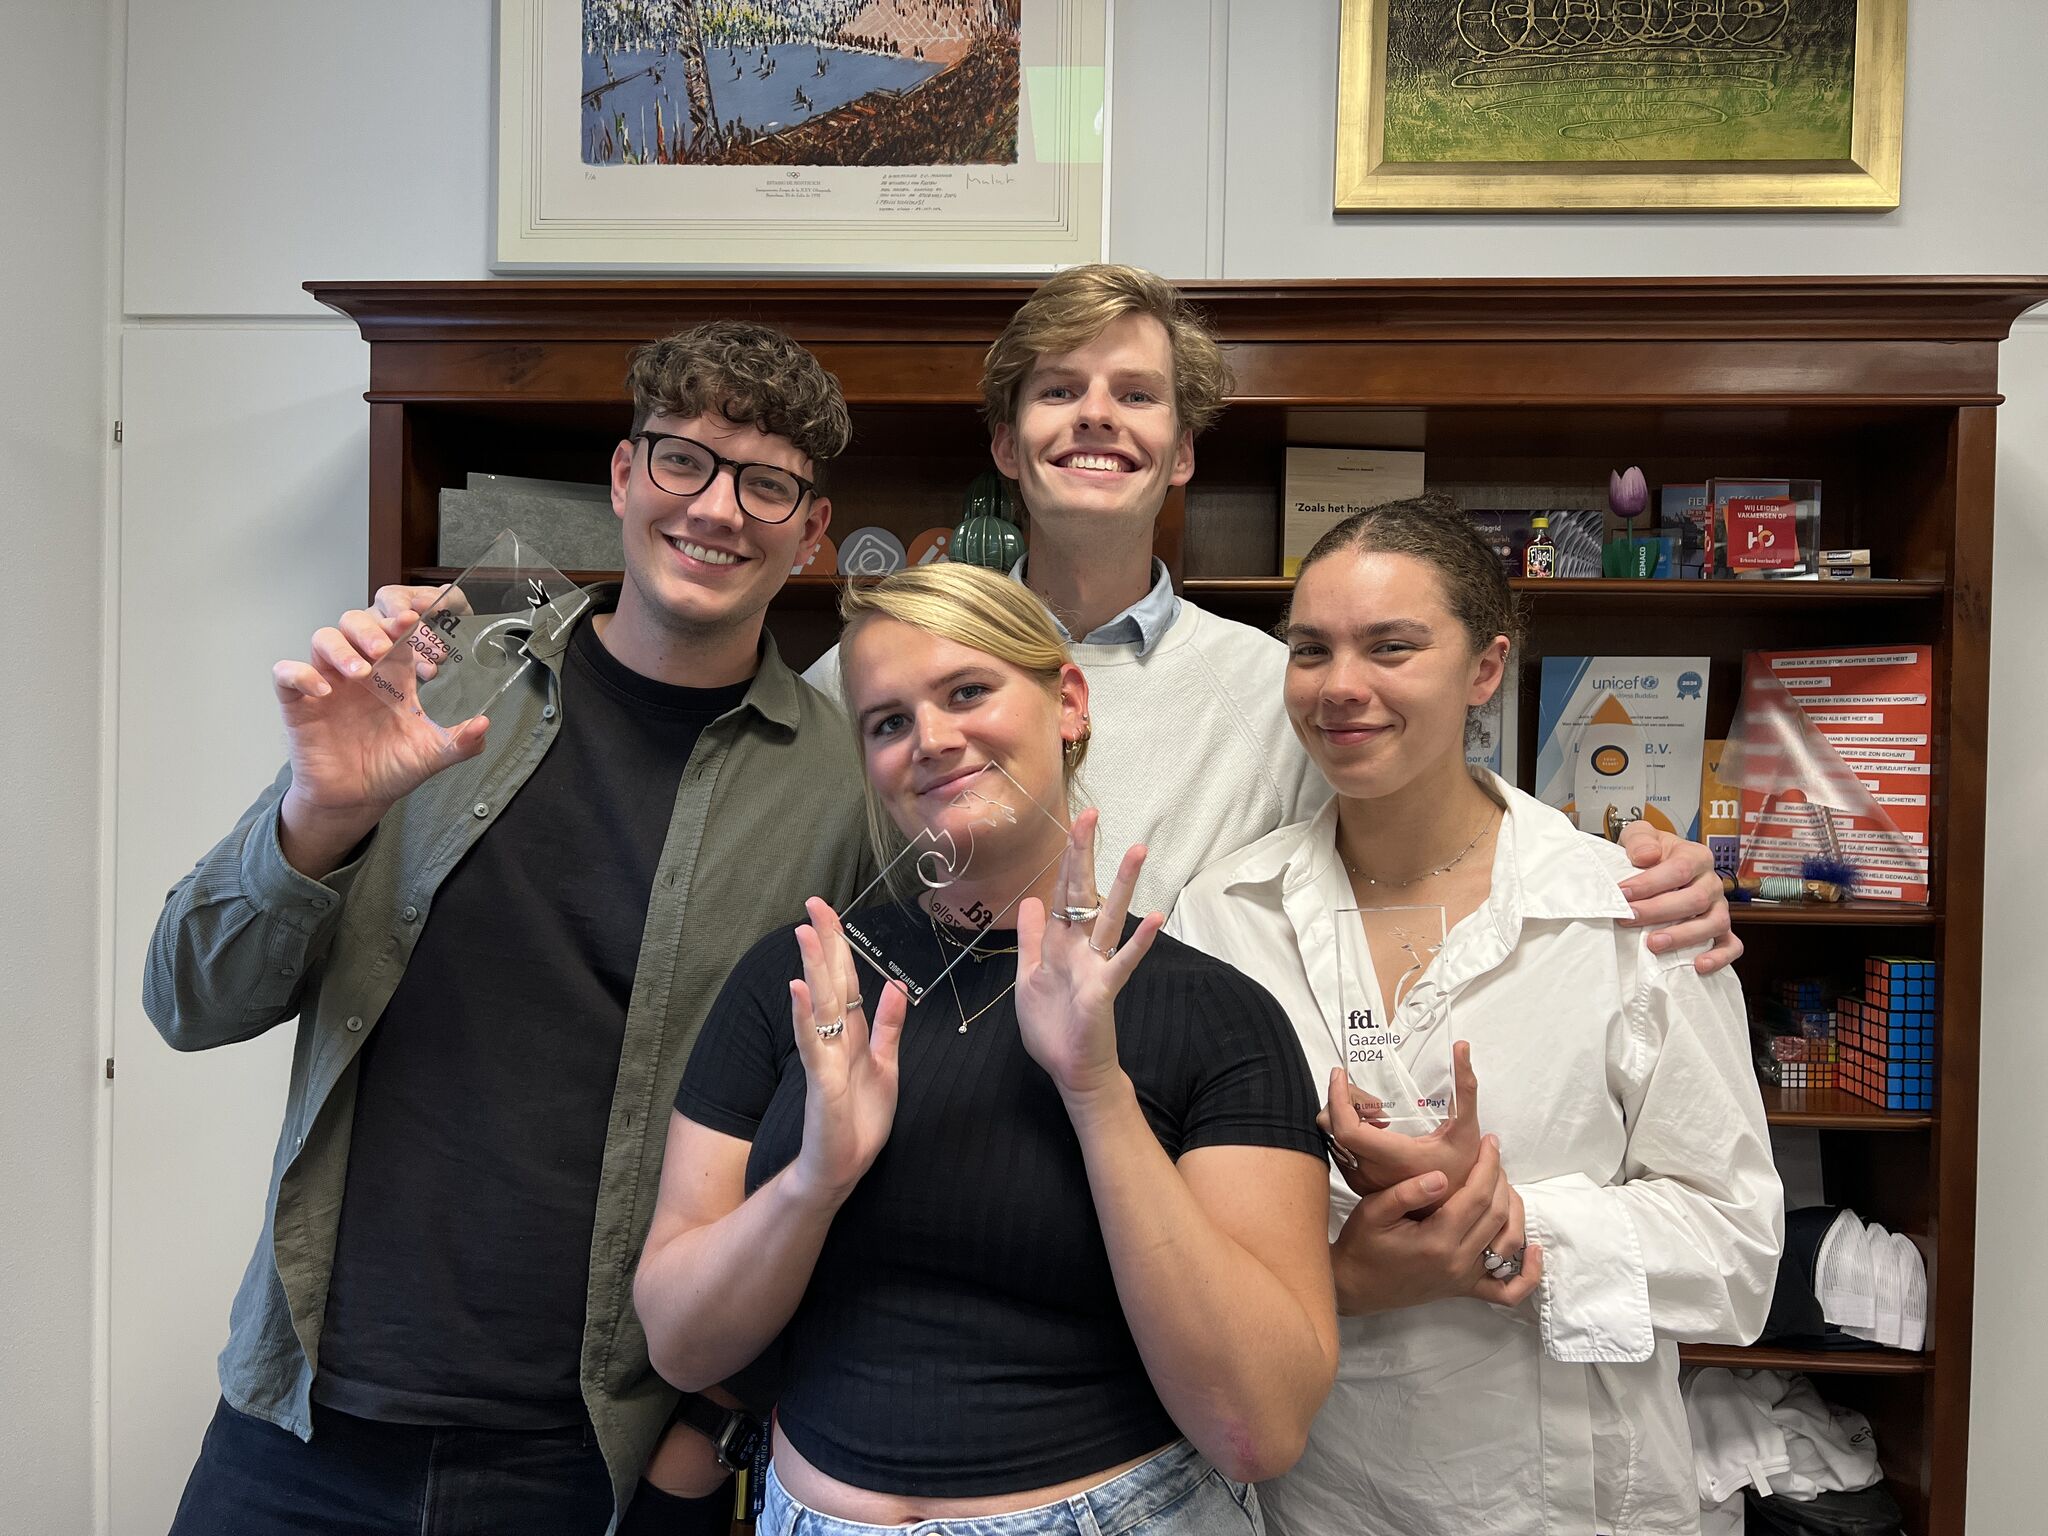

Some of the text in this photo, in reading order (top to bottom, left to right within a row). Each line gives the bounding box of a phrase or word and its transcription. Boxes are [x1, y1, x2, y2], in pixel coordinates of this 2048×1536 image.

[1328, 503, 1344, 513] het
[1744, 504, 1779, 512] WIJ LEIDEN
[431, 609, 461, 639] fd.
[406, 636, 441, 664] 2022
[419, 623, 464, 664] Gazelle
[371, 671, 405, 702] logitech
[1592, 675, 1639, 690] unicef
[1348, 1009, 1380, 1030] fd.
[1348, 1033, 1401, 1046] Gazelle
[1350, 1050, 1384, 1063] 2024
[1426, 1098, 1446, 1108] Payt
